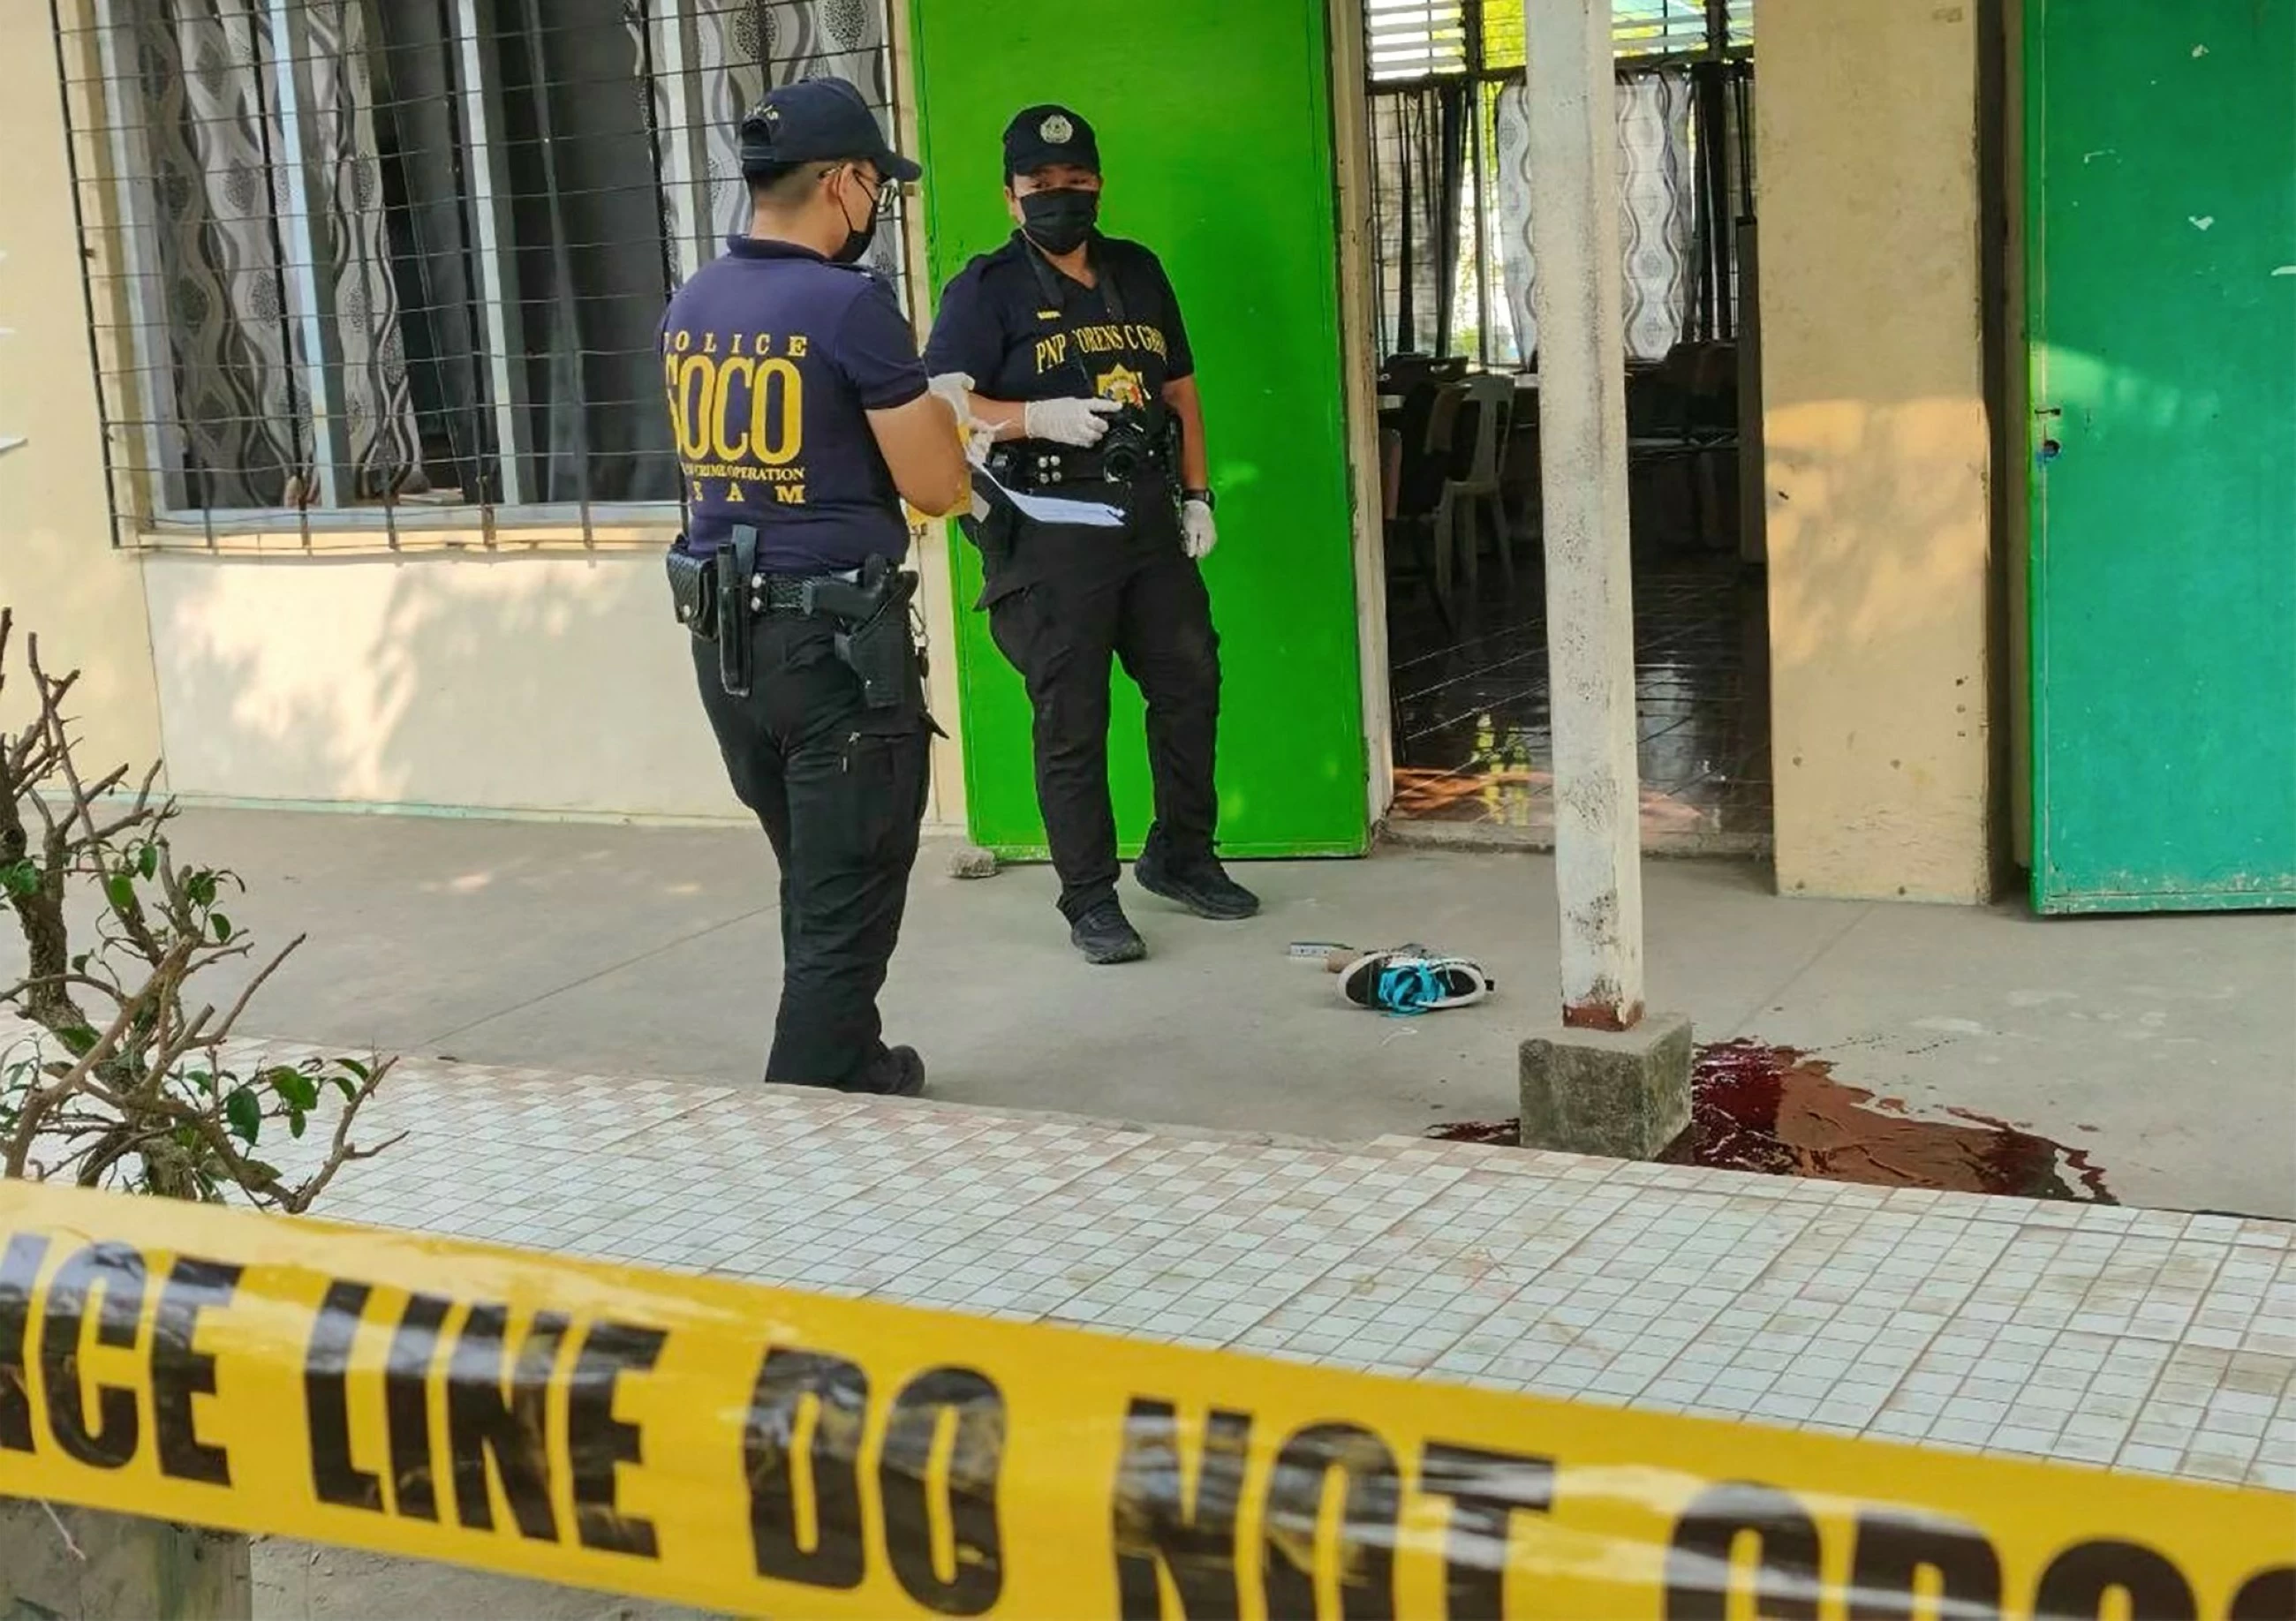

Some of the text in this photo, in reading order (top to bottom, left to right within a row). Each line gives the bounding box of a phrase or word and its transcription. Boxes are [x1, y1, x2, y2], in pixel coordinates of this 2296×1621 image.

[1036, 333, 1066, 375] PNP
[1071, 325, 1139, 353] ORENSC
[727, 464, 805, 481] OPERATION
[305, 1278, 669, 1560] LINE
[741, 1345, 1008, 1617] DO
[1110, 1395, 1557, 1621] NOT
